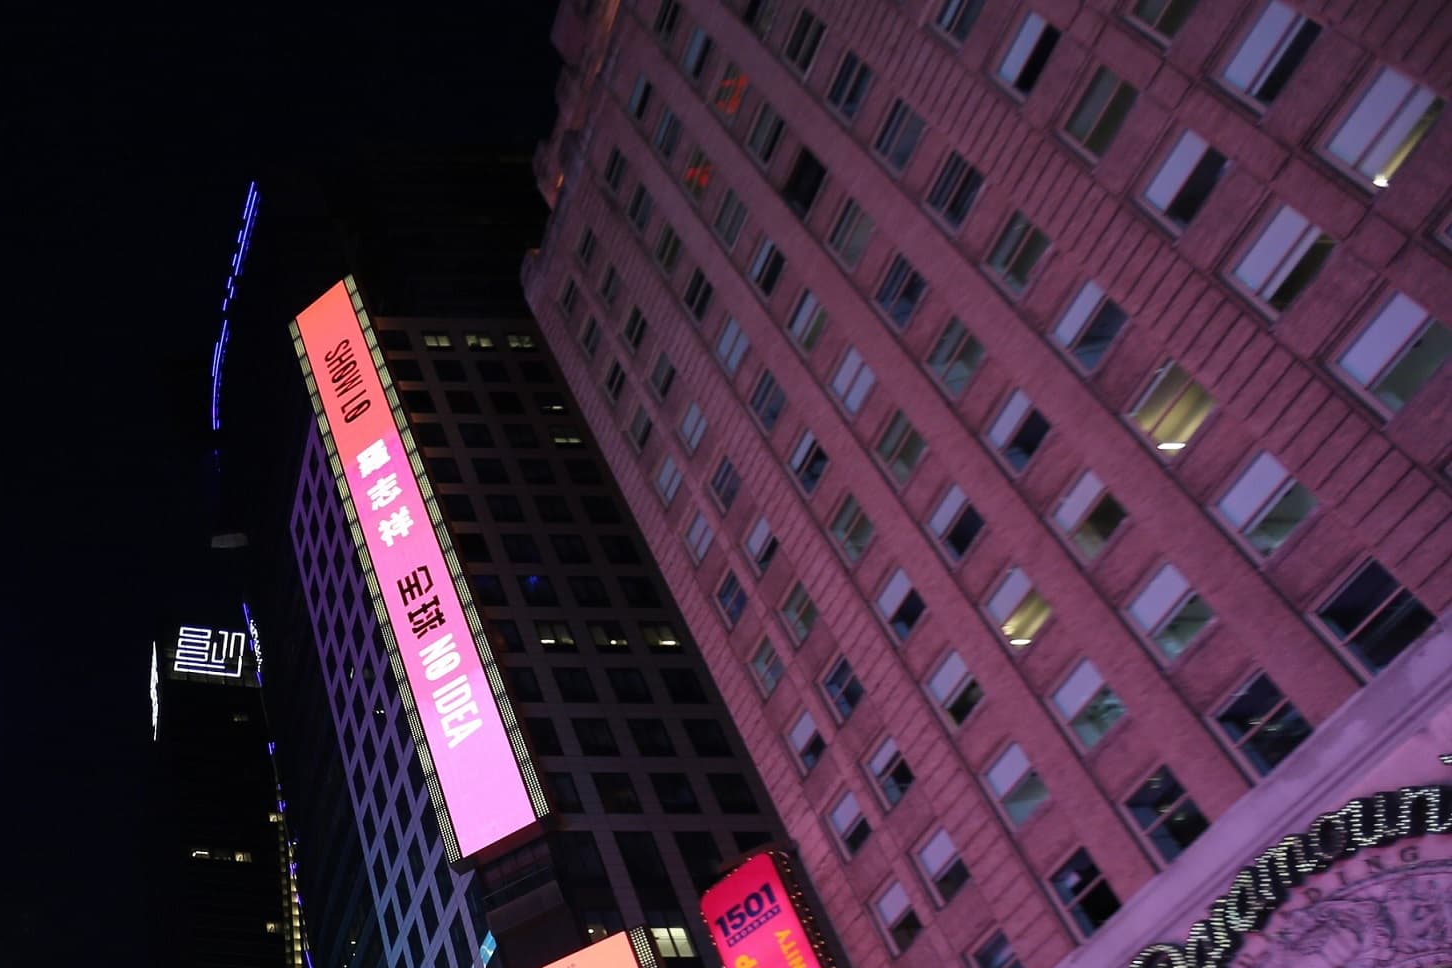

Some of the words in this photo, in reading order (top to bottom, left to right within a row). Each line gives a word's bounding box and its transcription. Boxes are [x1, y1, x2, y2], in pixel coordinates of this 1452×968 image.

[324, 339, 363, 398] SHOW
[419, 633, 461, 681] NO
[432, 674, 483, 749] IDEA
[714, 882, 778, 938] 1501
